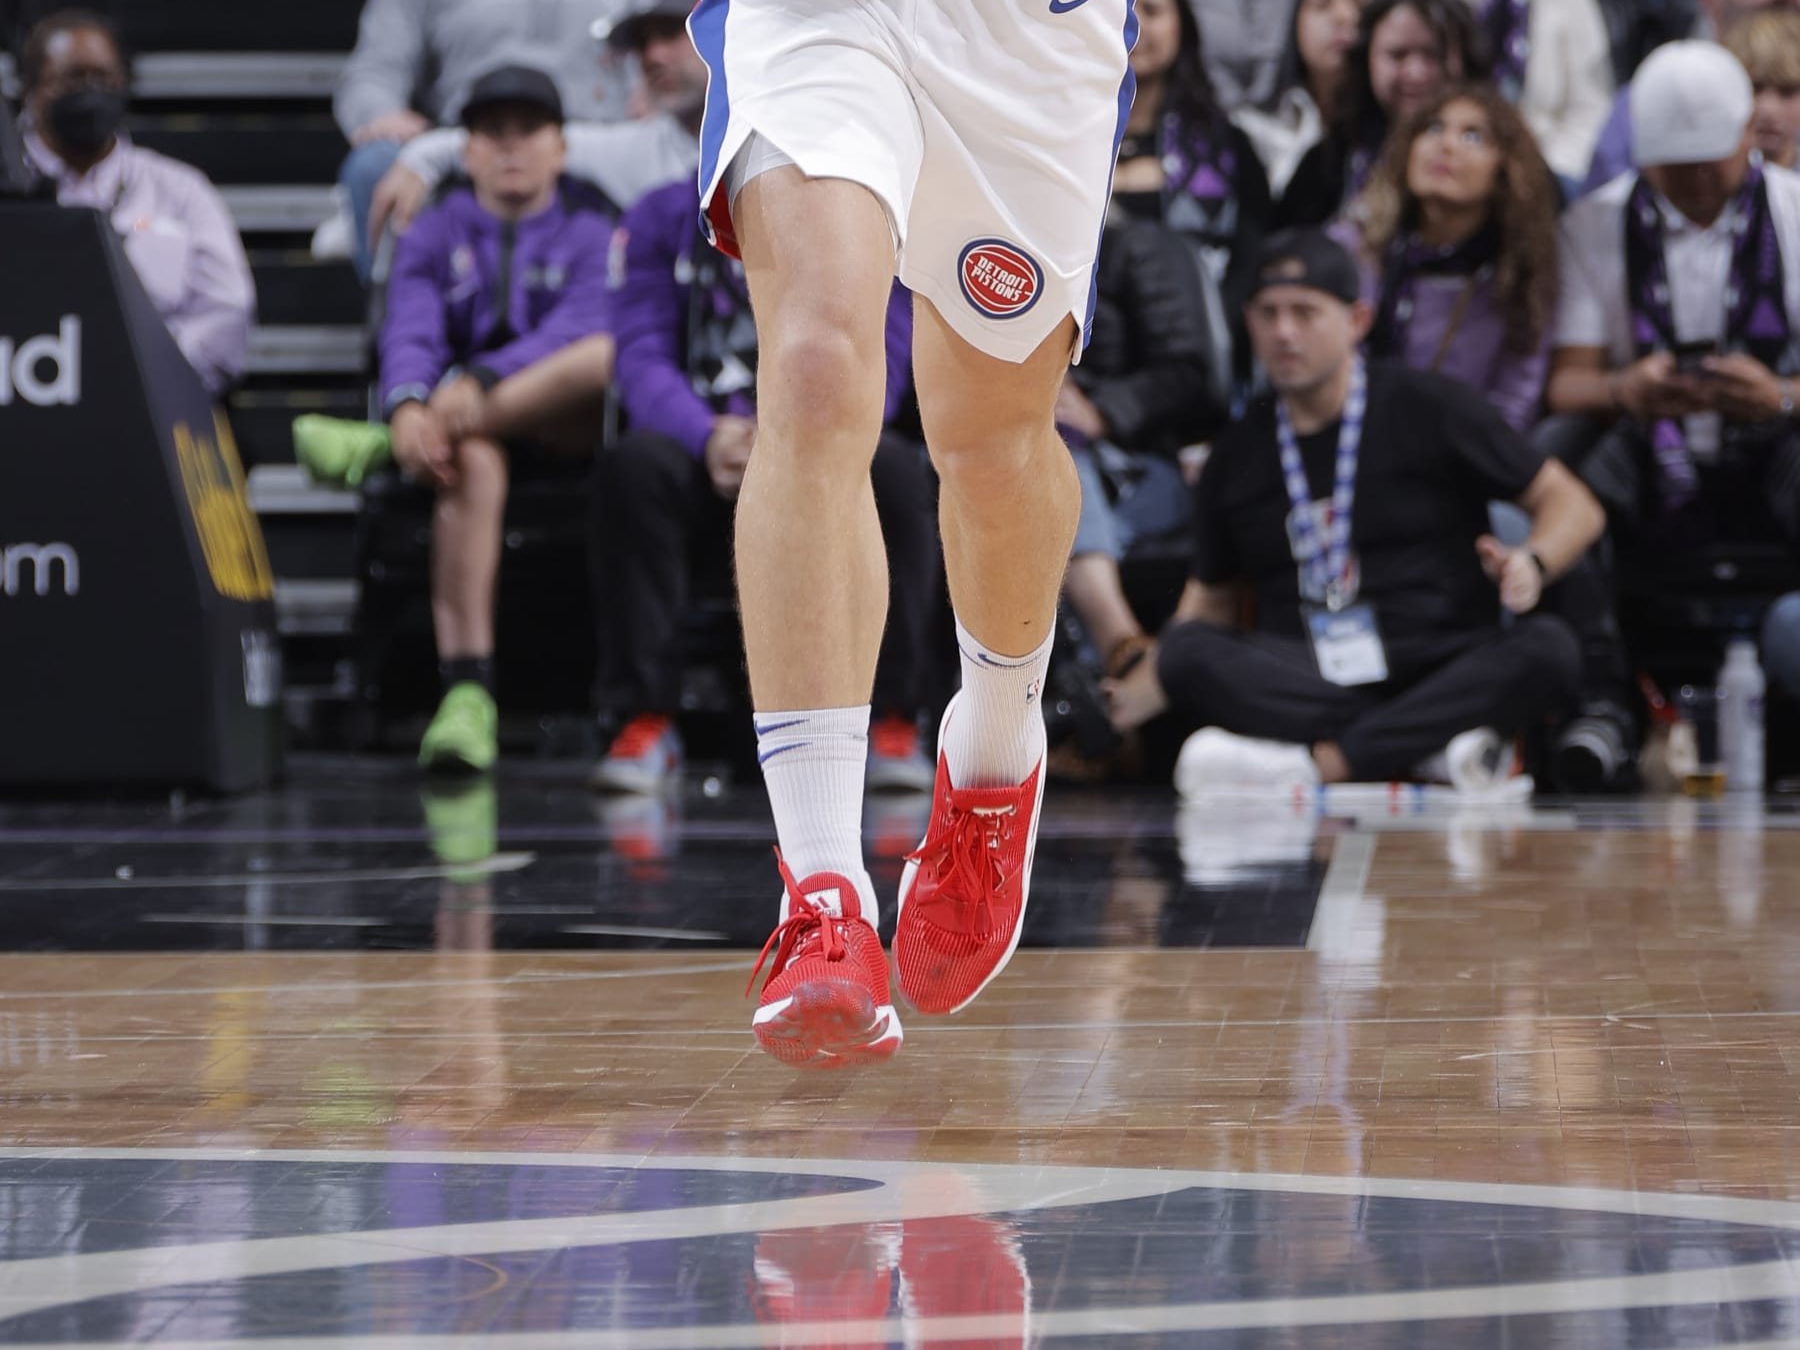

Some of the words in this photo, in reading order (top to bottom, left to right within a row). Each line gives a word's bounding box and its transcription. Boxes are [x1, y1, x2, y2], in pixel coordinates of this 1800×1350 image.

[971, 265, 1022, 302] PISTONS
[977, 255, 1028, 290] DETROIT
[0, 313, 82, 406] d
[0, 541, 80, 596] m
